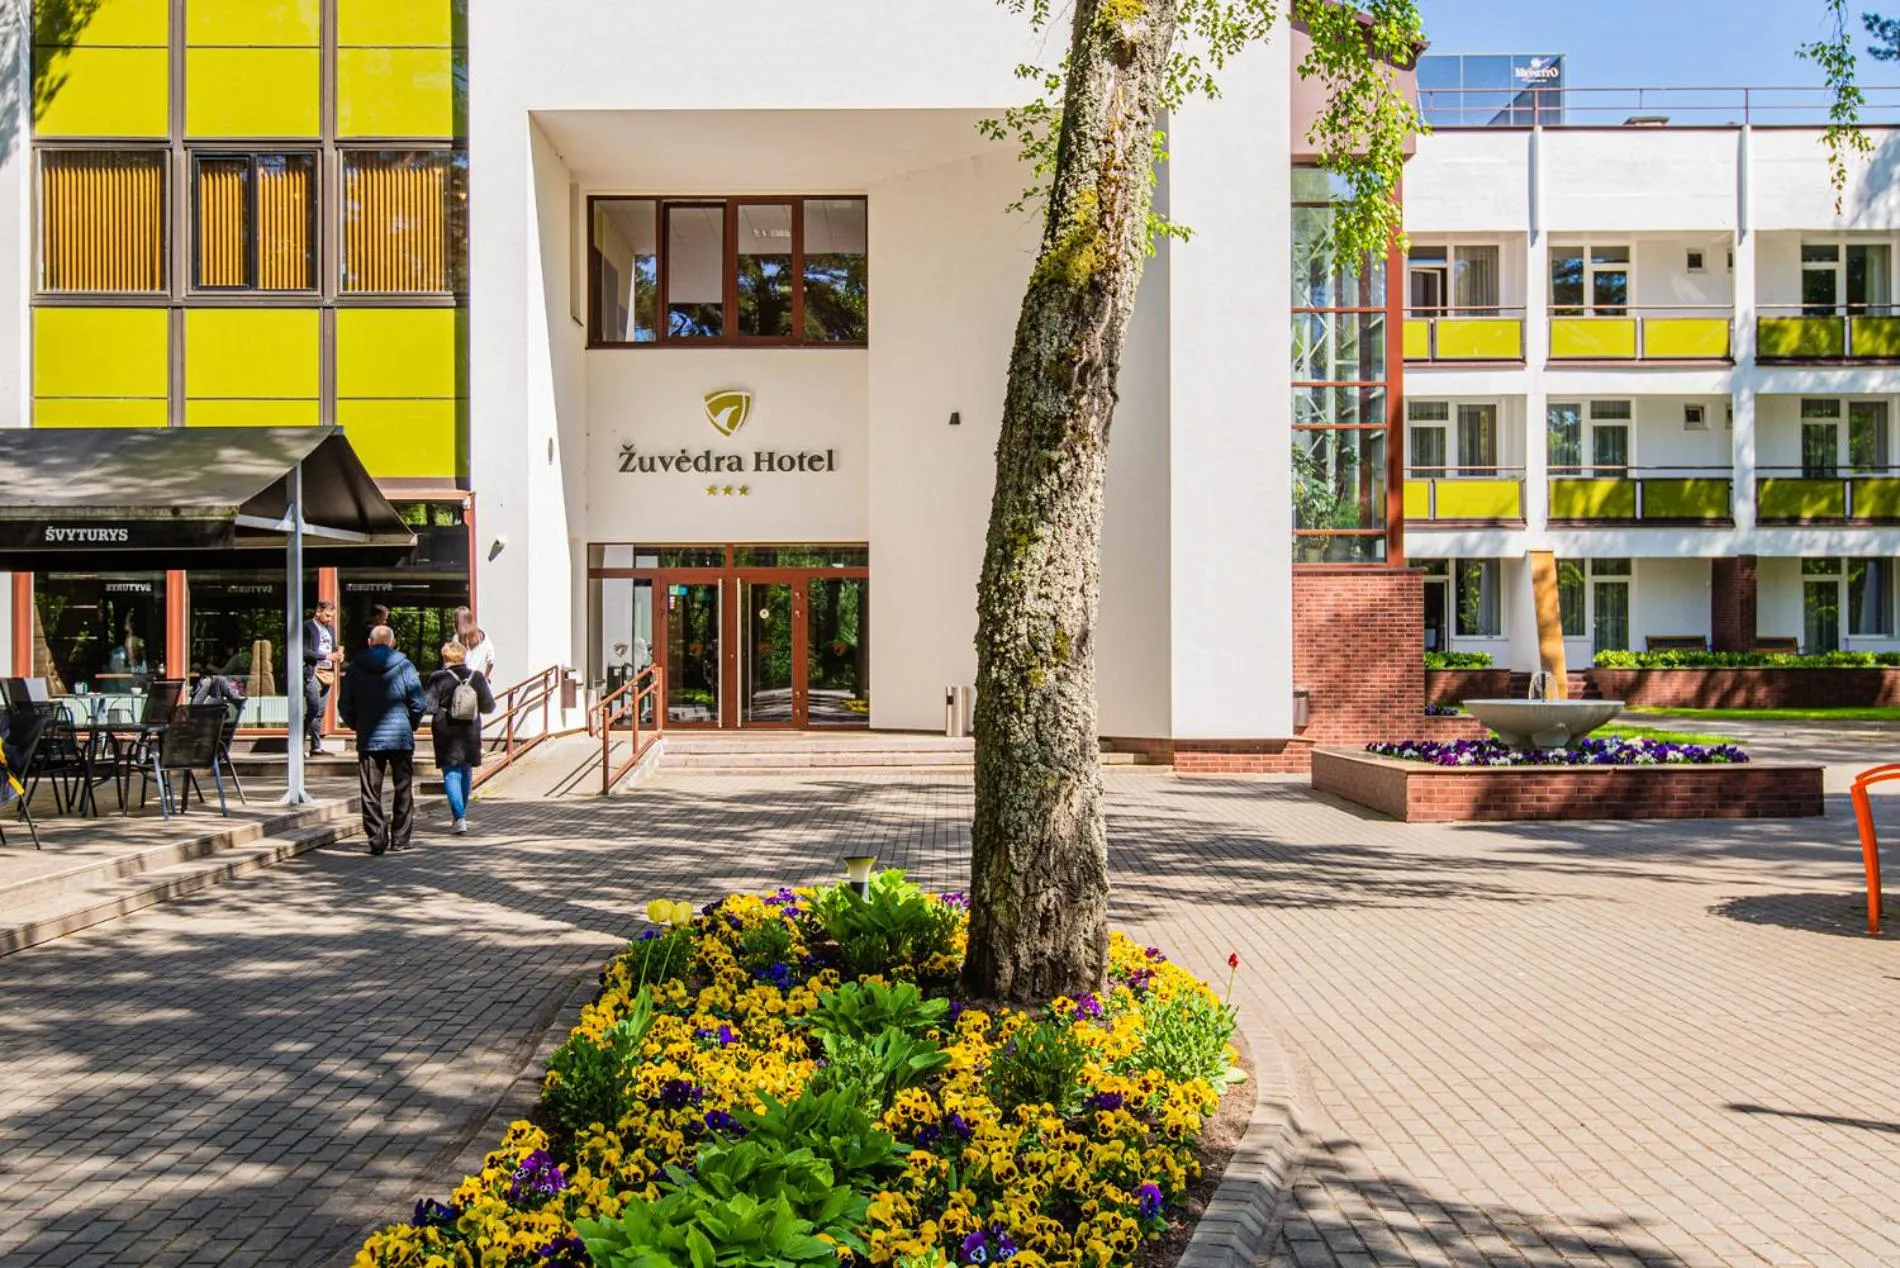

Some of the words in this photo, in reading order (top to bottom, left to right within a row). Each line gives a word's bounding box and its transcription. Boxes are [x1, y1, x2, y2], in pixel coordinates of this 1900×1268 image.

[618, 444, 744, 473] Žuvėdra
[753, 448, 835, 472] Hotel
[44, 525, 128, 541] ŠVYTURYS
